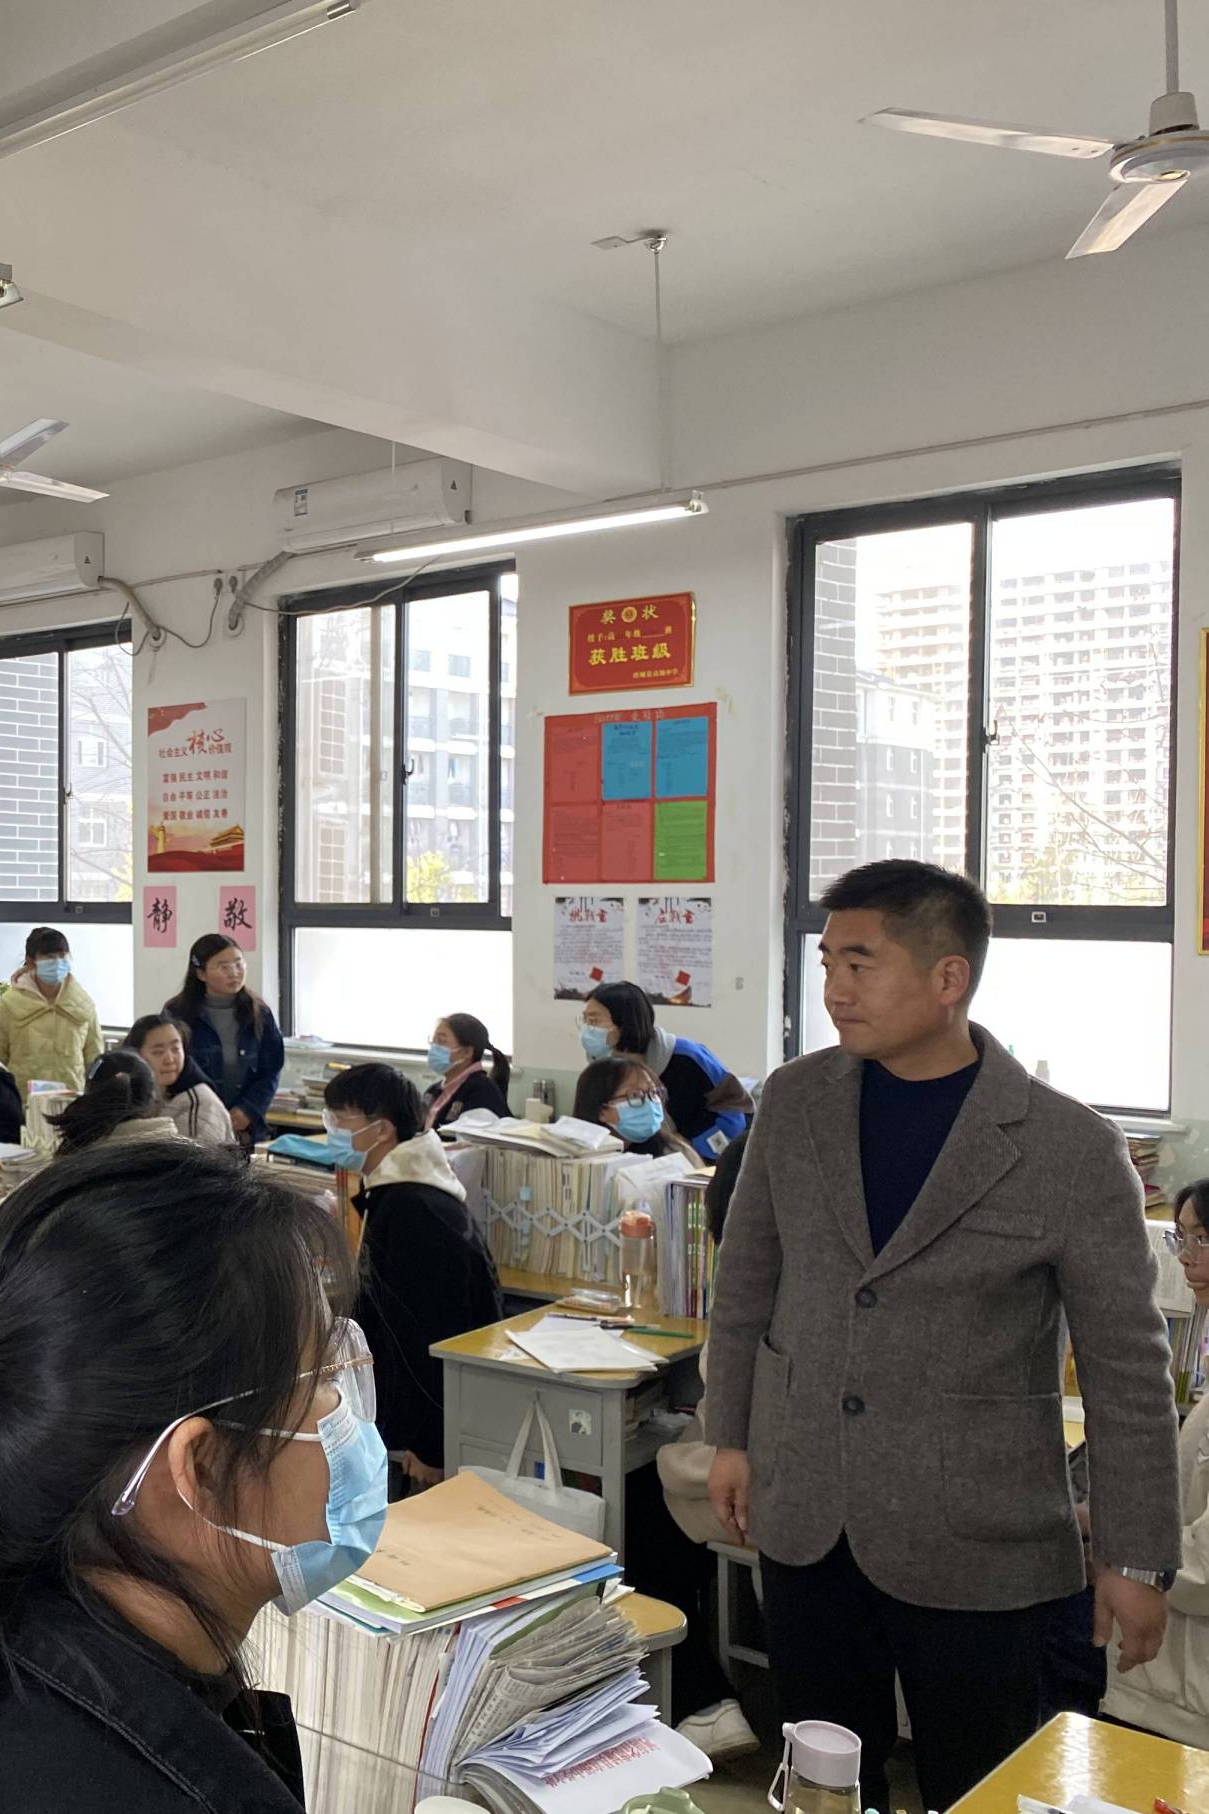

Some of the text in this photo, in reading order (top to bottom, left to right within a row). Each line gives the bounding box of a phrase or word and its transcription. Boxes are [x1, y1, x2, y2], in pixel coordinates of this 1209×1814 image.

[588, 642, 671, 666] 获胜班级
[147, 897, 173, 934] 静
